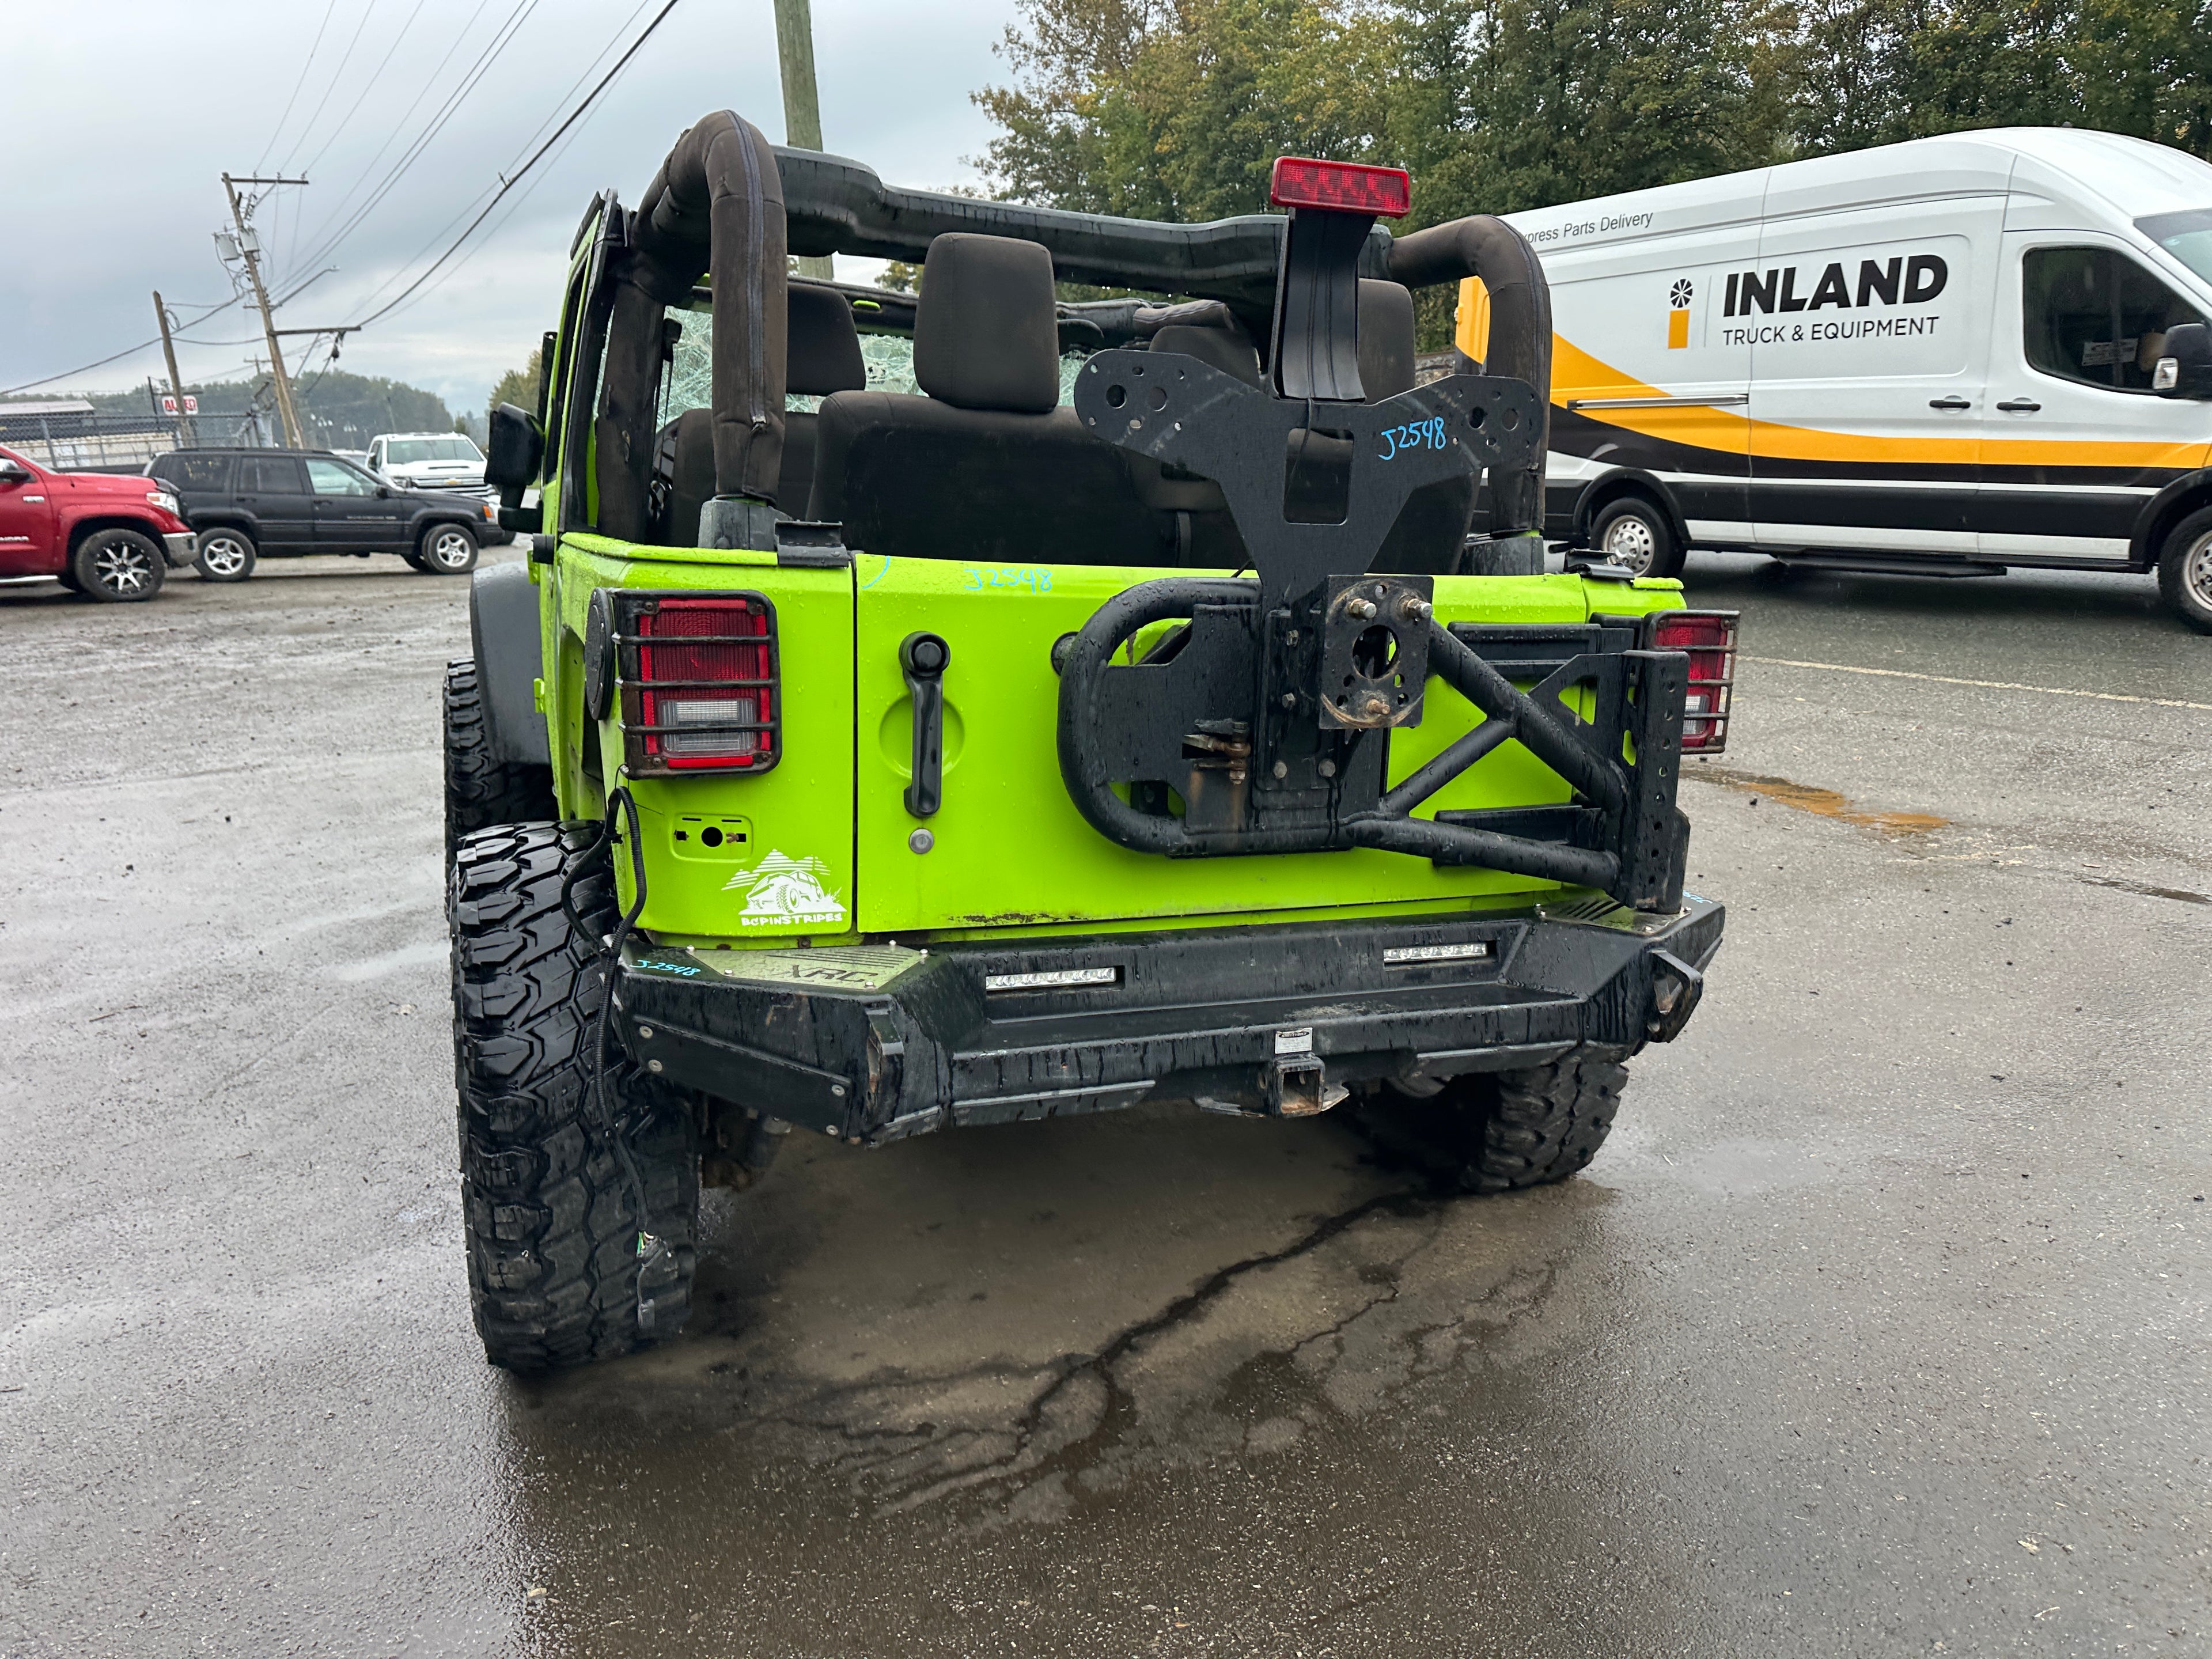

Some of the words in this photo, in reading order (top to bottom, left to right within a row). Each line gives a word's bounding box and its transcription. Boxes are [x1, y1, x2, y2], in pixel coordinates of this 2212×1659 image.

[1563, 221, 1595, 238] Parts
[1600, 212, 1654, 232] Delivery
[1723, 254, 1948, 317] INLAND
[1722, 325, 1786, 346] TRUCK
[1791, 324, 1804, 342] &
[1810, 316, 1940, 341] EQUIPMENT
[1377, 416, 1448, 461] J2548
[963, 567, 1054, 595] J2548
[740, 913, 843, 927] BCPINSTRIPES
[628, 959, 701, 976] J2548
[779, 964, 879, 983] XRC
